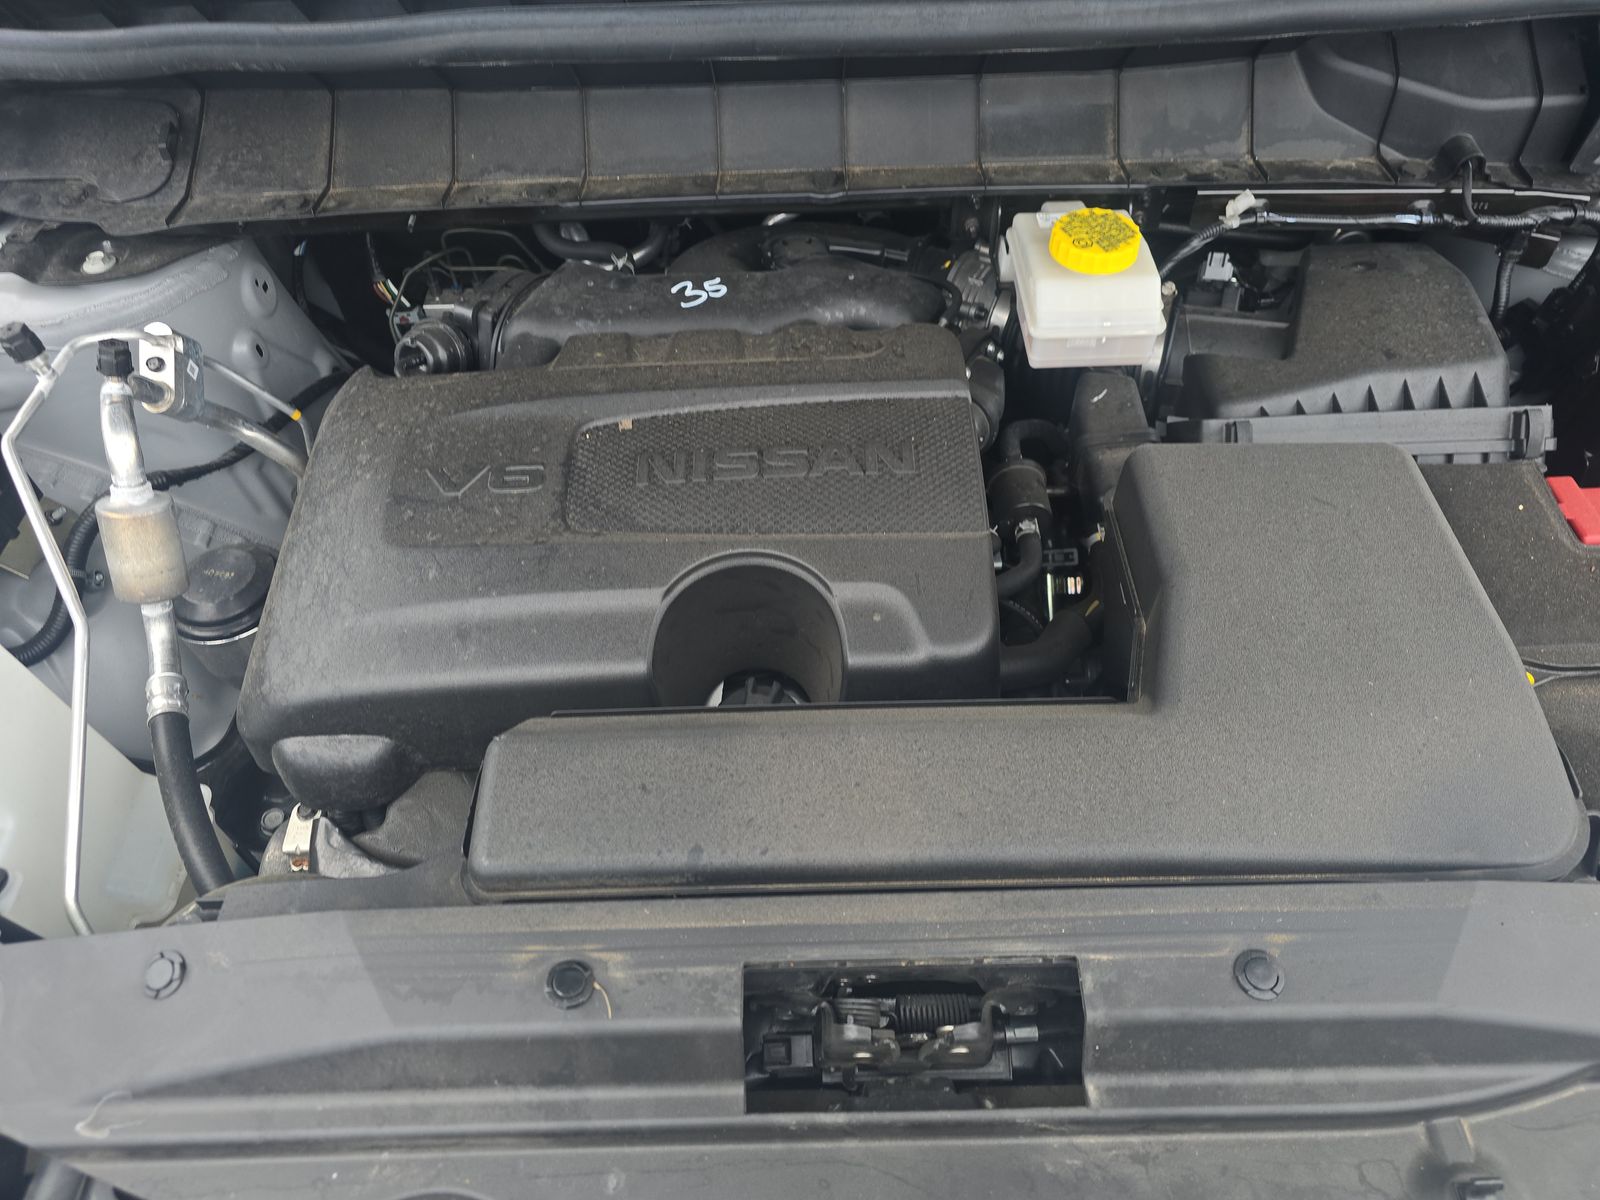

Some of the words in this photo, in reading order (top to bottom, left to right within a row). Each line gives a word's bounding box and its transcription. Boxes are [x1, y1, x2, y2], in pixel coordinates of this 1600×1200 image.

[670, 276, 728, 309] 35
[425, 464, 546, 498] V6
[635, 441, 917, 487] NISSAN
